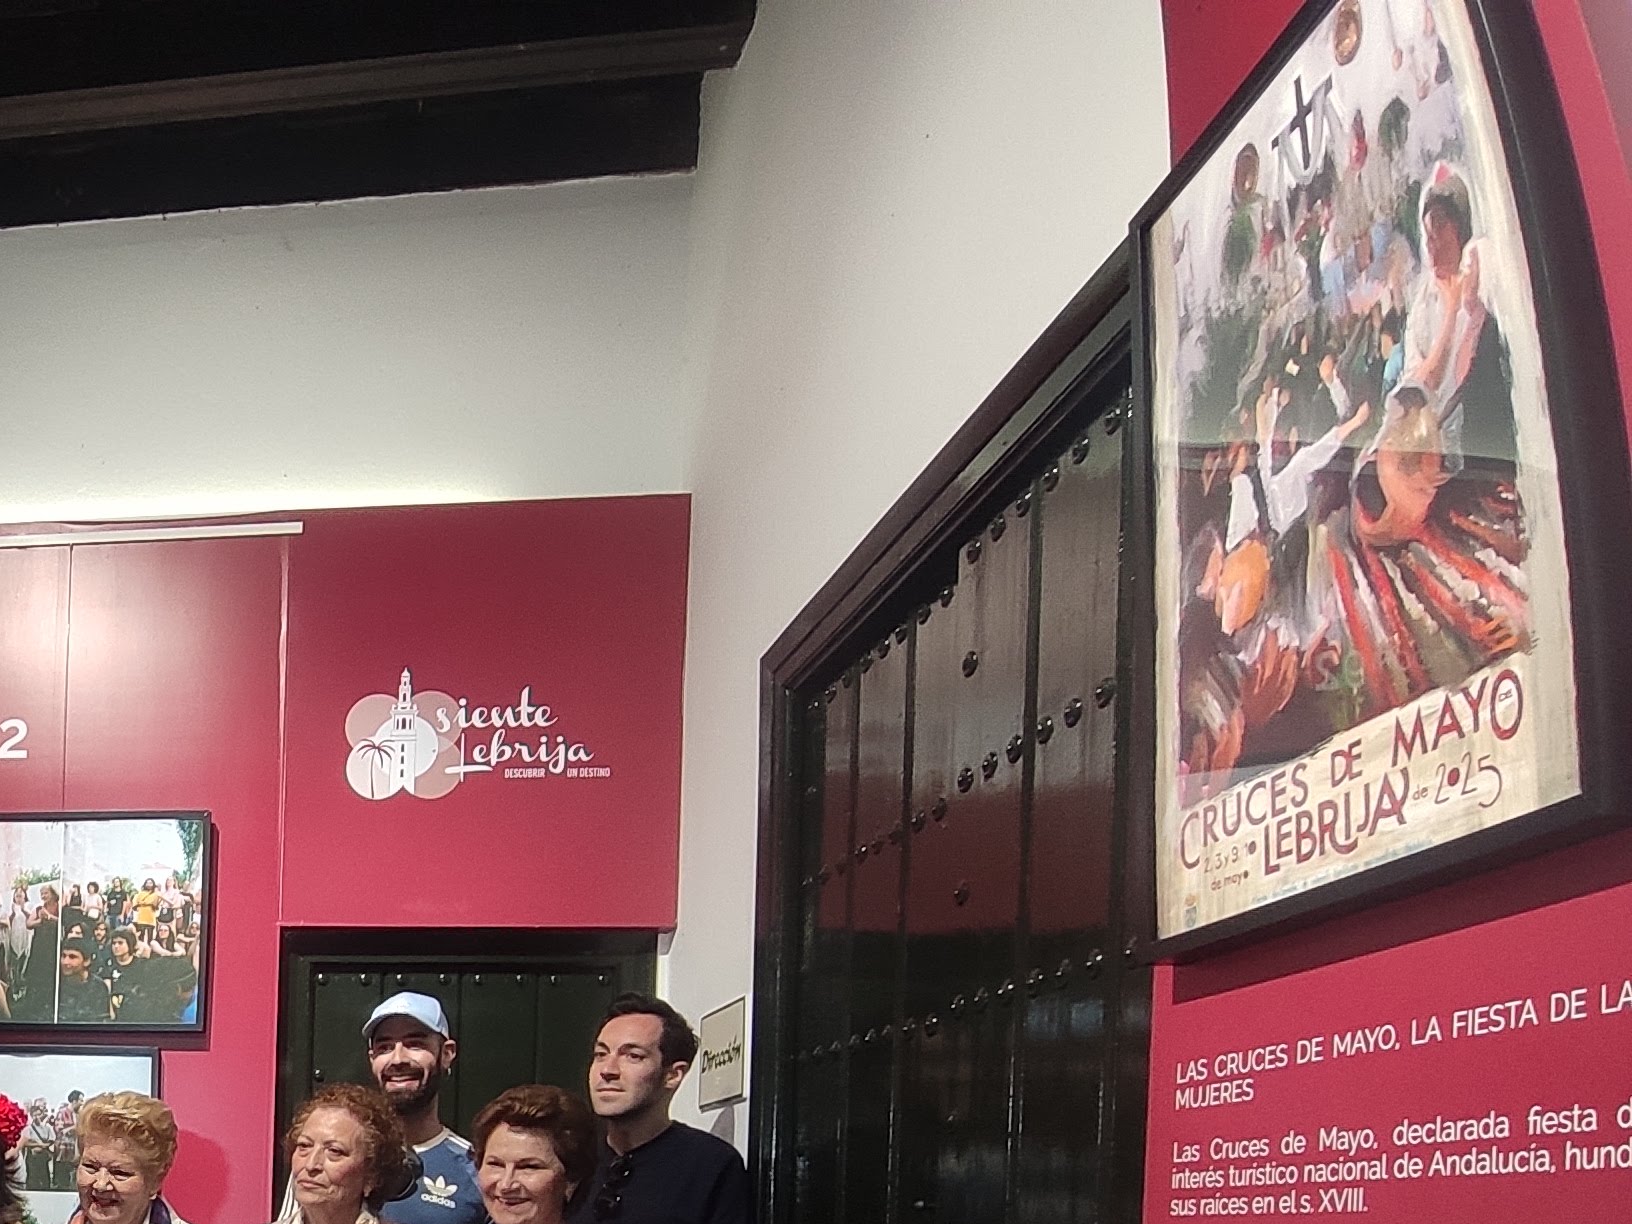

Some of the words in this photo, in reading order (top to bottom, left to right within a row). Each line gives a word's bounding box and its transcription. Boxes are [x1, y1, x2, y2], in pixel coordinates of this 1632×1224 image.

[436, 686, 558, 733] siente
[444, 729, 594, 782] Lebrija
[504, 768, 546, 778] DESCUBRIR
[579, 767, 611, 778] DESTINO
[1180, 762, 1309, 870] CRUCES
[1330, 739, 1363, 788] DE
[1391, 669, 1524, 768] MAYO
[1263, 767, 1411, 876] LEBRIJA
[1177, 1059, 1208, 1084] LAS
[1214, 1044, 1288, 1077] CRUCES
[1297, 1037, 1324, 1064] DE
[1411, 1015, 1442, 1045] LA
[1453, 998, 1538, 1038] FIESTA
[1550, 988, 1588, 1022] DE
[1176, 1079, 1254, 1110] MUJERES
[421, 1193, 456, 1209] adidas
